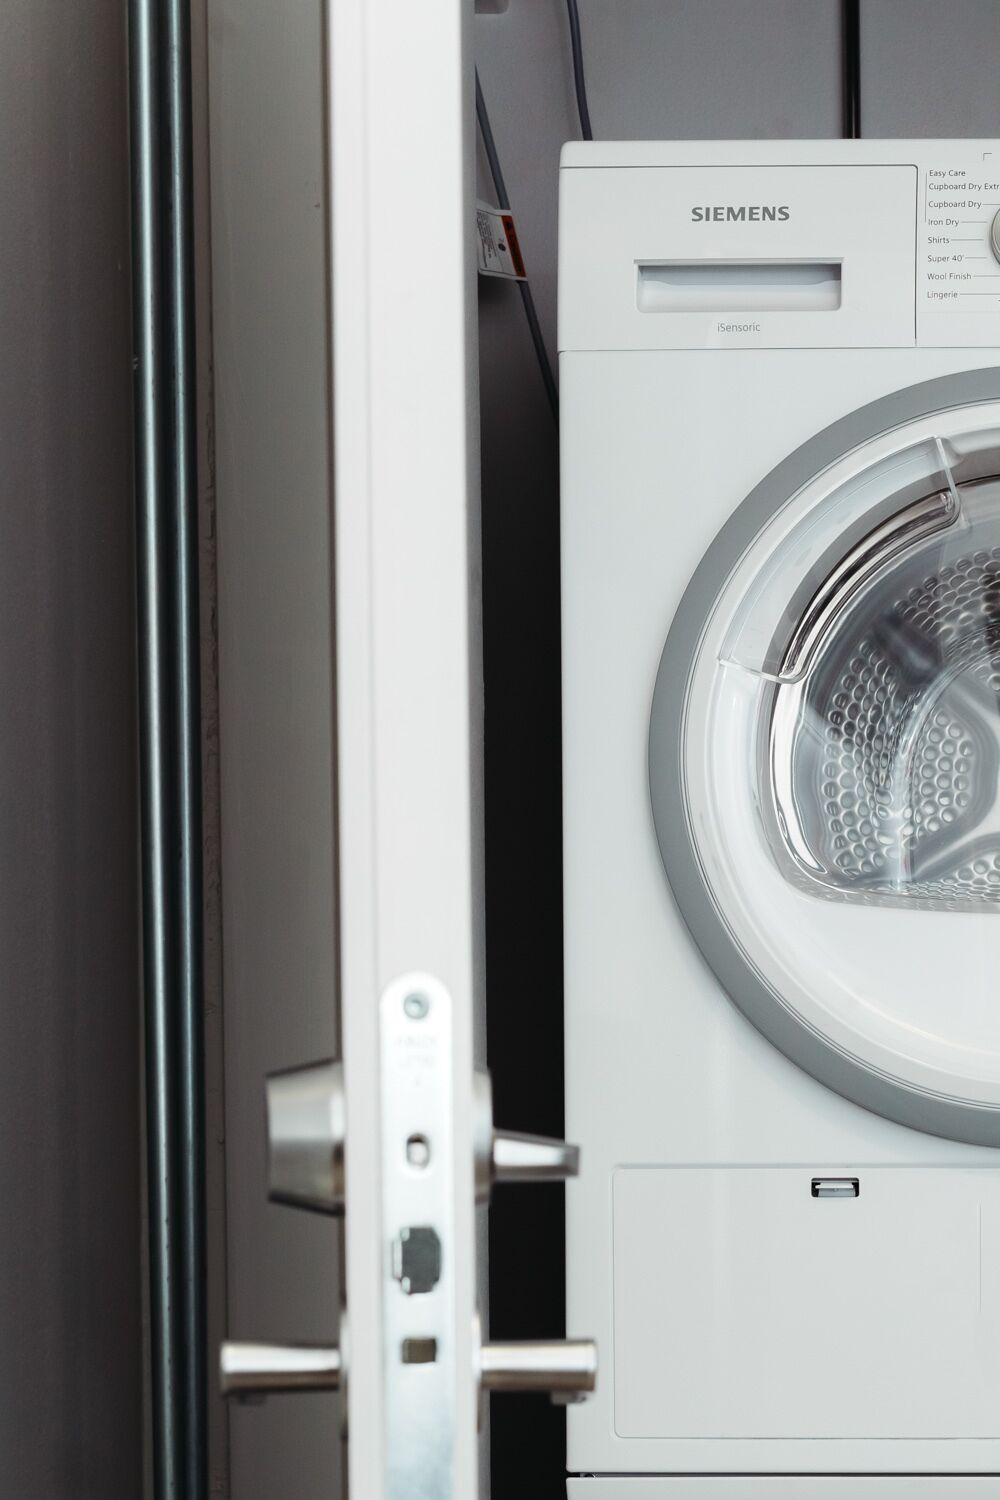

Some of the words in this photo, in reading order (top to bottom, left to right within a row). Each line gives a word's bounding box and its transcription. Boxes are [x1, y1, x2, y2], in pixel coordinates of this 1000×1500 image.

[929, 169, 947, 179] Easy
[948, 169, 966, 177] Care
[928, 182, 967, 192] Cupboard
[968, 182, 983, 192] Dry
[928, 200, 966, 210] Cupboard
[967, 200, 983, 210] Dry
[691, 205, 790, 222] SIEMENS
[928, 218, 944, 226] Iron
[945, 218, 960, 227] Dry
[927, 236, 950, 244] Shirts
[927, 254, 950, 263] Super
[927, 272, 947, 280] Wool
[949, 272, 972, 280] Finish
[927, 290, 958, 300] Lingerie
[717, 322, 761, 333] iSensoric
